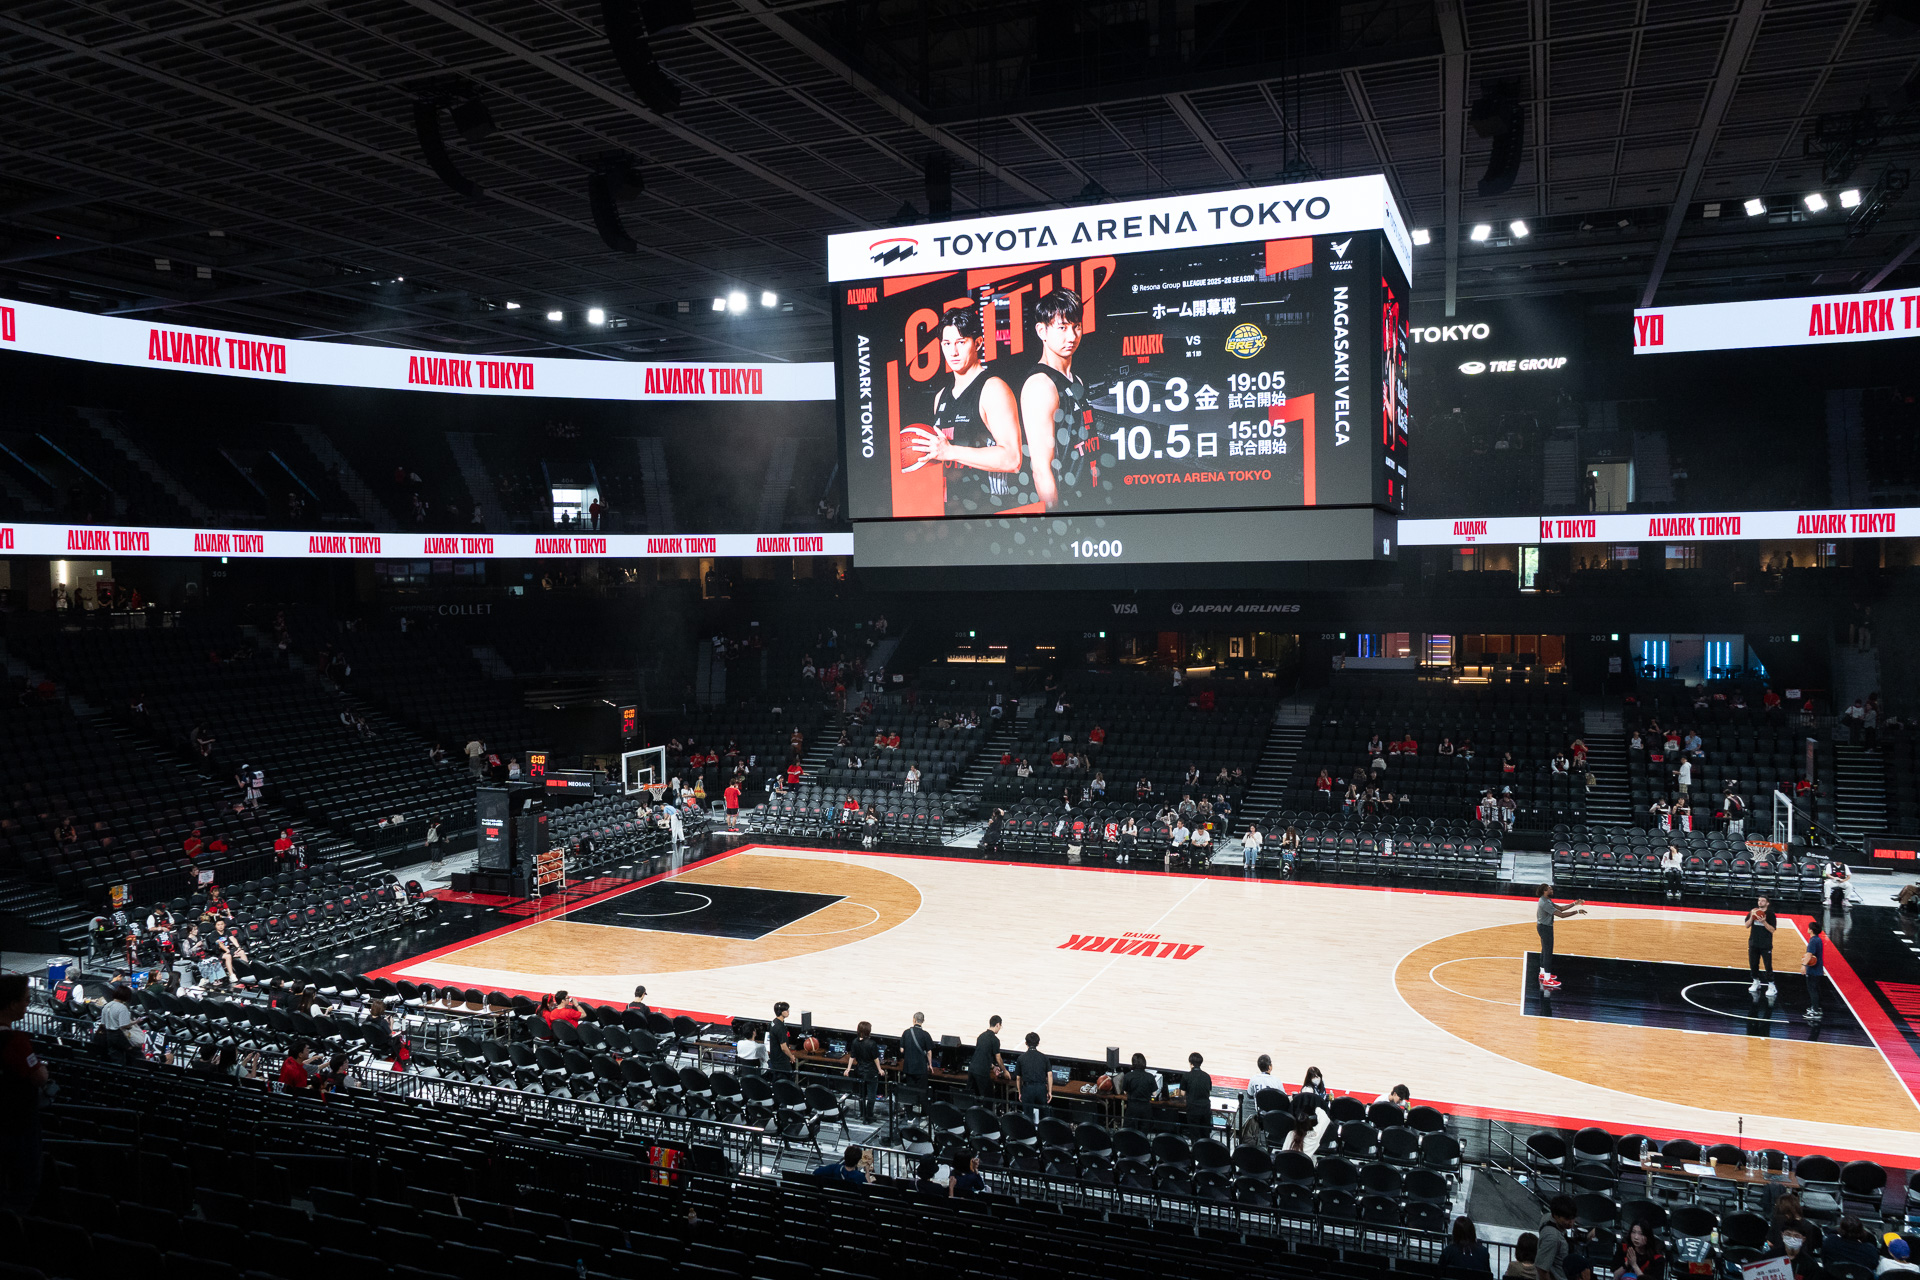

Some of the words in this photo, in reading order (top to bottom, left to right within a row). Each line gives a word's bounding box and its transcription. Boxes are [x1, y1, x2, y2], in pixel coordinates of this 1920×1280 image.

[934, 224, 1057, 257] TOYOTA
[1071, 210, 1198, 243] ARENA
[1207, 196, 1331, 230] TOKYO
[1139, 283, 1161, 292] Resona
[1162, 281, 1181, 290] Group
[1182, 278, 1207, 288] B.LEAGUE
[1207, 276, 1232, 286] 2025-26
[1232, 274, 1256, 284] SEASON
[847, 287, 878, 305] ALVARK
[1152, 298, 1237, 320] ホーム開幕戦
[1809, 297, 1895, 337] ALVARK
[1185, 336, 1202, 346] VS
[1333, 286, 1350, 382] NAGASAKI
[1410, 322, 1491, 344] TOKYO
[148, 328, 222, 368] ALVARK
[225, 338, 287, 375] TOKYO
[1122, 333, 1165, 357] ALVARK
[1227, 338, 1265, 350] BREX
[408, 355, 473, 388] ALVARK
[475, 360, 535, 391] TOKYO
[857, 334, 873, 400] ALVARK
[1489, 359, 1517, 374] TRE
[1518, 356, 1568, 372] GROUP
[644, 367, 706, 395] ALVARK
[708, 368, 763, 395] TOKYO
[1227, 371, 1286, 392] 19:05
[1108, 377, 1190, 415] 10.3
[1194, 384, 1221, 411] 金
[1228, 391, 1287, 410] 試合開始
[1334, 385, 1351, 447] VELCA
[860, 401, 875, 459] TOKYO
[1228, 419, 1287, 440] 15:05
[1110, 423, 1192, 461] 10.5
[1197, 432, 1218, 458] 日
[1229, 438, 1288, 457] 試合開始
[1123, 473, 1181, 486] @TOYOTA
[1183, 471, 1226, 484] ARENA
[1227, 469, 1272, 482] TOKYO
[1453, 521, 1488, 536] ALVARK
[1556, 519, 1597, 539] TOKYO
[1648, 517, 1696, 537] ALVARK
[1698, 516, 1742, 536] TOKYO
[1796, 513, 1847, 535] ALVARK
[1850, 512, 1896, 534] TOKYO
[67, 529, 111, 551] ALVARK
[112, 531, 150, 552] TOKYO
[193, 533, 231, 553] ALVARK
[232, 534, 264, 553] TOKYO
[309, 536, 347, 553] ALVARK
[348, 536, 381, 554] TOKYO
[423, 537, 459, 555] ALVARK
[461, 537, 494, 554] TOKYO
[535, 538, 572, 555] ALVARK
[573, 538, 607, 555] TOKYO
[646, 538, 683, 554] ALVARK
[684, 537, 717, 554] TOKYO
[756, 537, 791, 553] ALVARK
[793, 536, 824, 553] TOKYO
[1070, 540, 1123, 558] 10:00
[438, 603, 493, 616] COLLET
[1111, 603, 1138, 614] VISA
[1188, 604, 1232, 613] JAPAN
[1234, 604, 1301, 613] AIRLINES
[1590, 634, 1607, 642] 202
[623, 719, 635, 732] 24
[530, 764, 545, 777] 24
[1122, 931, 1162, 940] TOKYO
[1056, 934, 1205, 961] ALVARK
